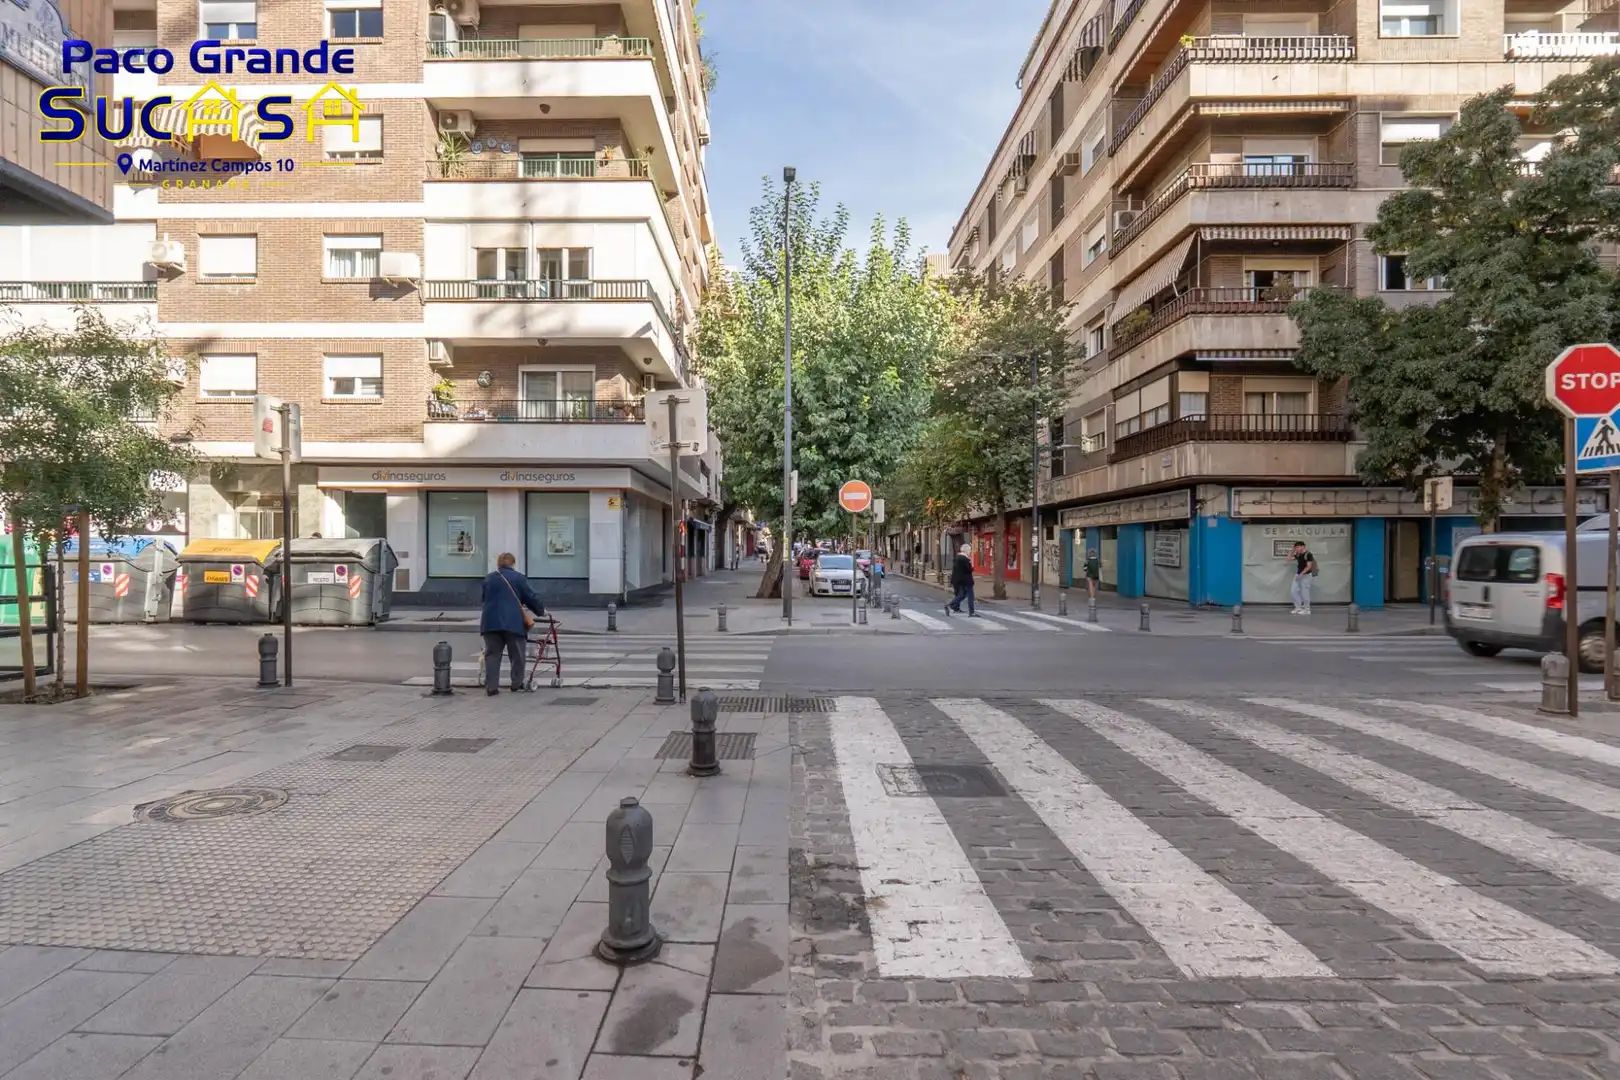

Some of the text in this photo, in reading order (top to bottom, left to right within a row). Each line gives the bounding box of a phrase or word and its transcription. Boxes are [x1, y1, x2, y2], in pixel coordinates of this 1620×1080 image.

[1560, 372, 1620, 390] STOP
[371, 469, 447, 483] divinaseguros
[500, 469, 576, 483] divinaseguros
[1264, 527, 1346, 536] SE ALQUILA
